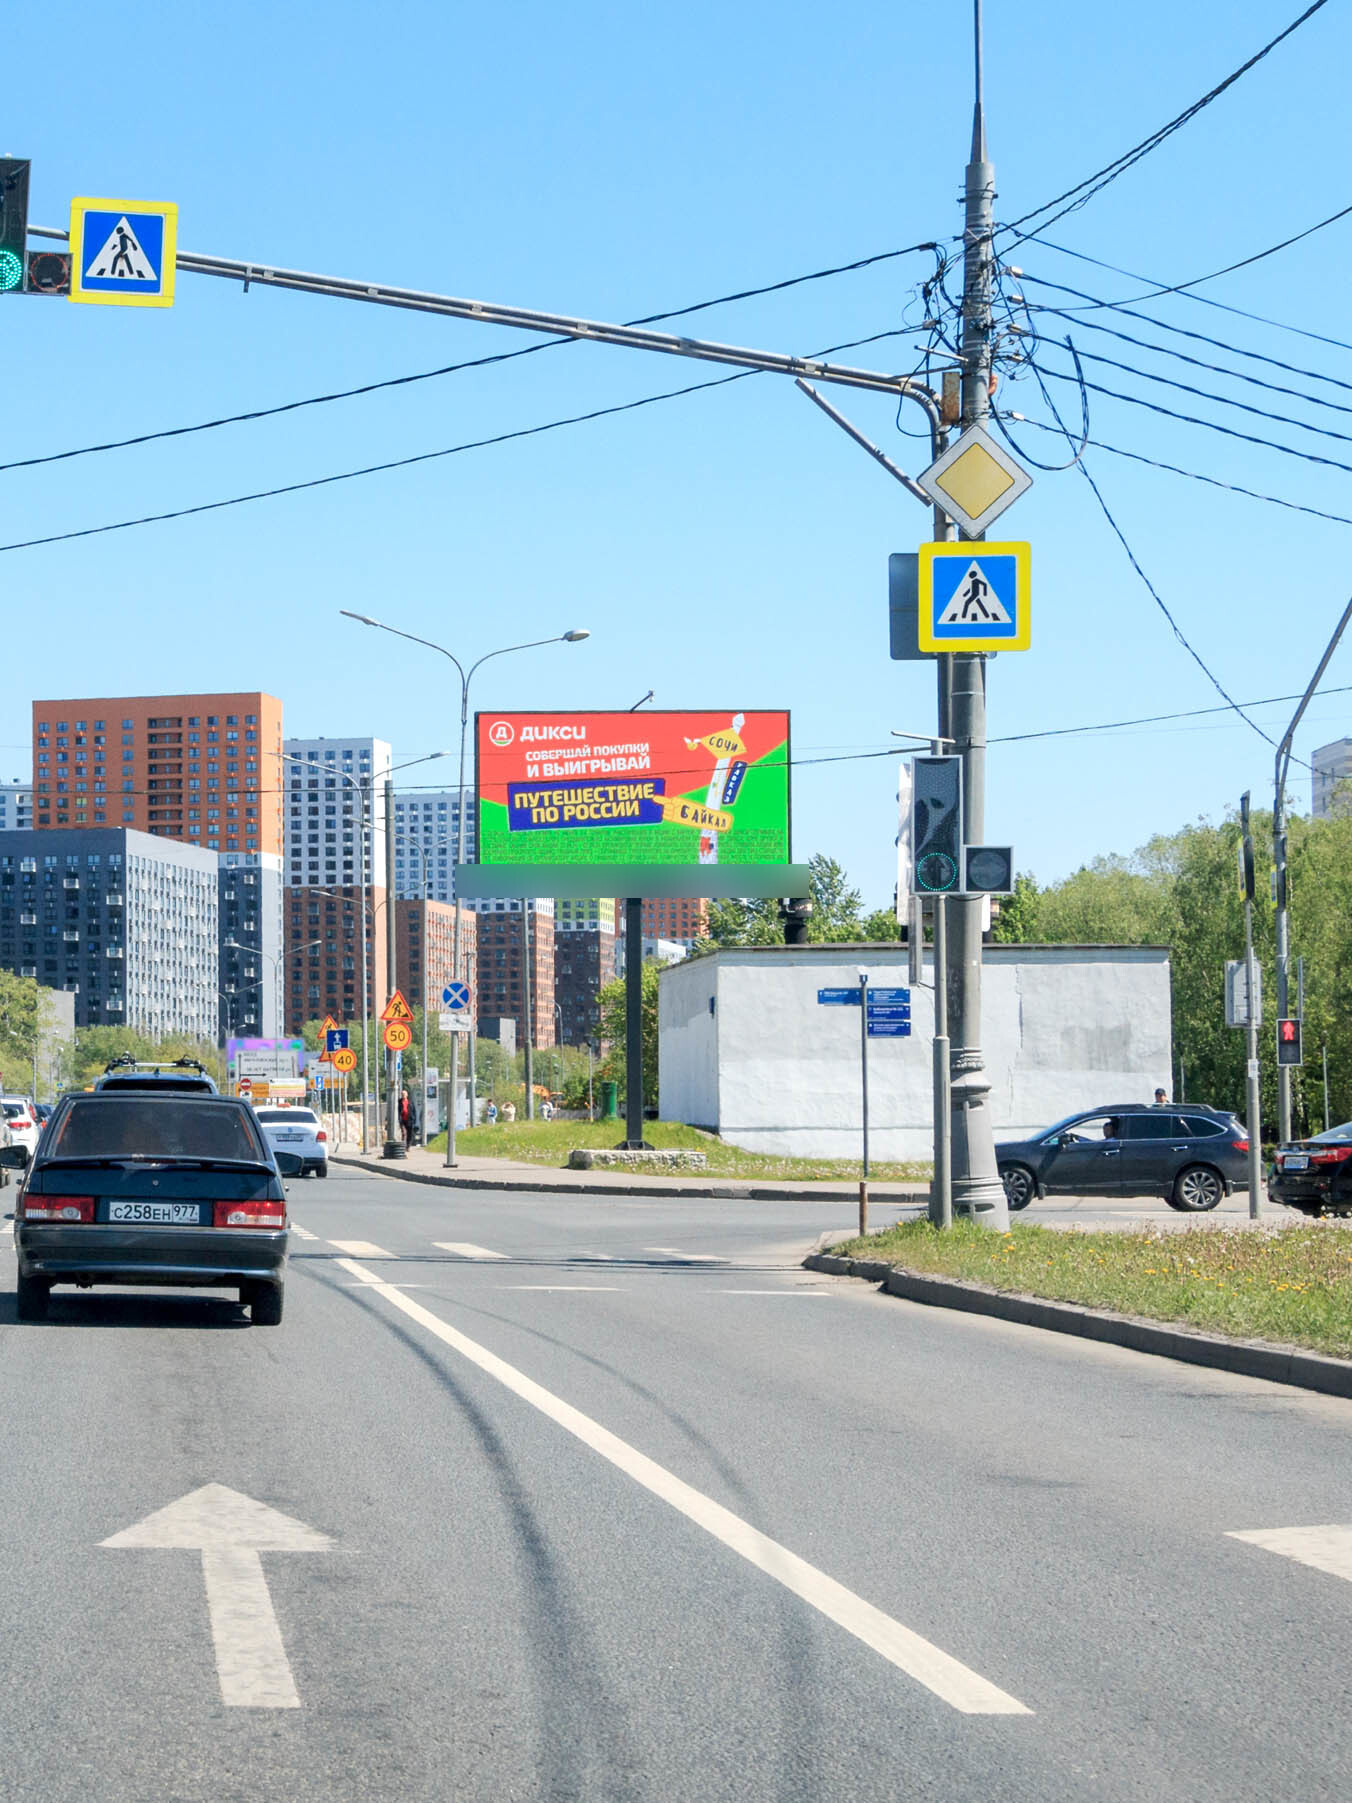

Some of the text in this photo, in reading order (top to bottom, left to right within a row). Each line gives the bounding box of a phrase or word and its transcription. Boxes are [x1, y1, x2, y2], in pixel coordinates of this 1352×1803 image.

[520, 725, 586, 742] ДИКСИ
[525, 742, 650, 762] СОВЕРШАЙ ПОКУПКИ
[708, 736, 738, 752] СОЧИ
[527, 753, 651, 778] И ВЫИГРЫВАЙ
[514, 783, 655, 809] ПУТЕШЕСТВИЕ
[532, 801, 641, 824] ПО РОССИИ
[680, 804, 726, 828] БАЙКАЛ
[390, 1030, 406, 1042] 50
[337, 1054, 352, 1065] 40
[173, 1205, 196, 1217] 977
